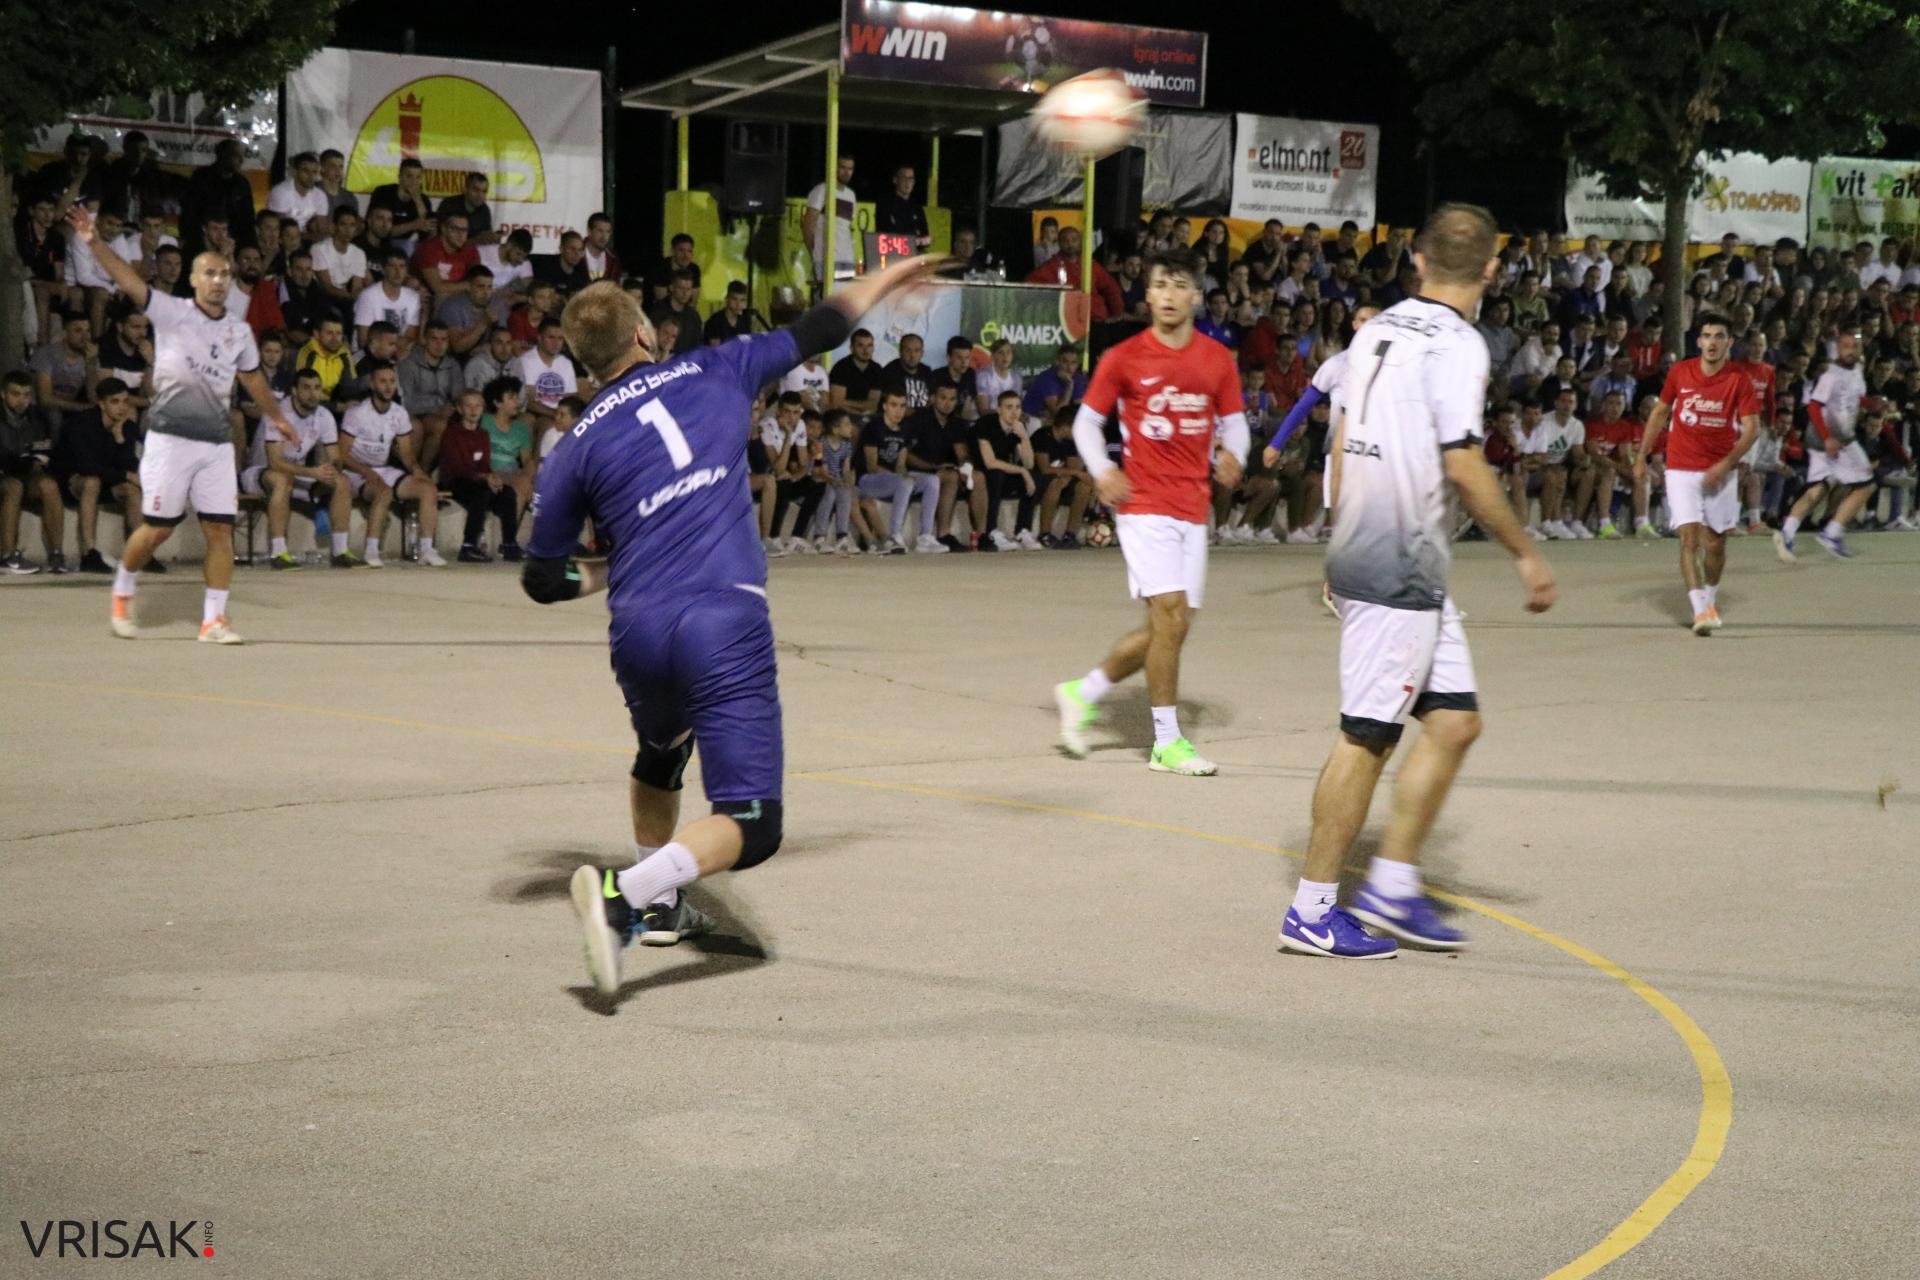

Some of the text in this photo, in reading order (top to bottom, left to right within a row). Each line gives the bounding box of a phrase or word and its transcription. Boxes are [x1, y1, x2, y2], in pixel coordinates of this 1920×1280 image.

[1259, 140, 1331, 173] elmont
[1001, 324, 1063, 345] NAMEX
[572, 378, 648, 438] DVORAC
[635, 396, 694, 471] 1
